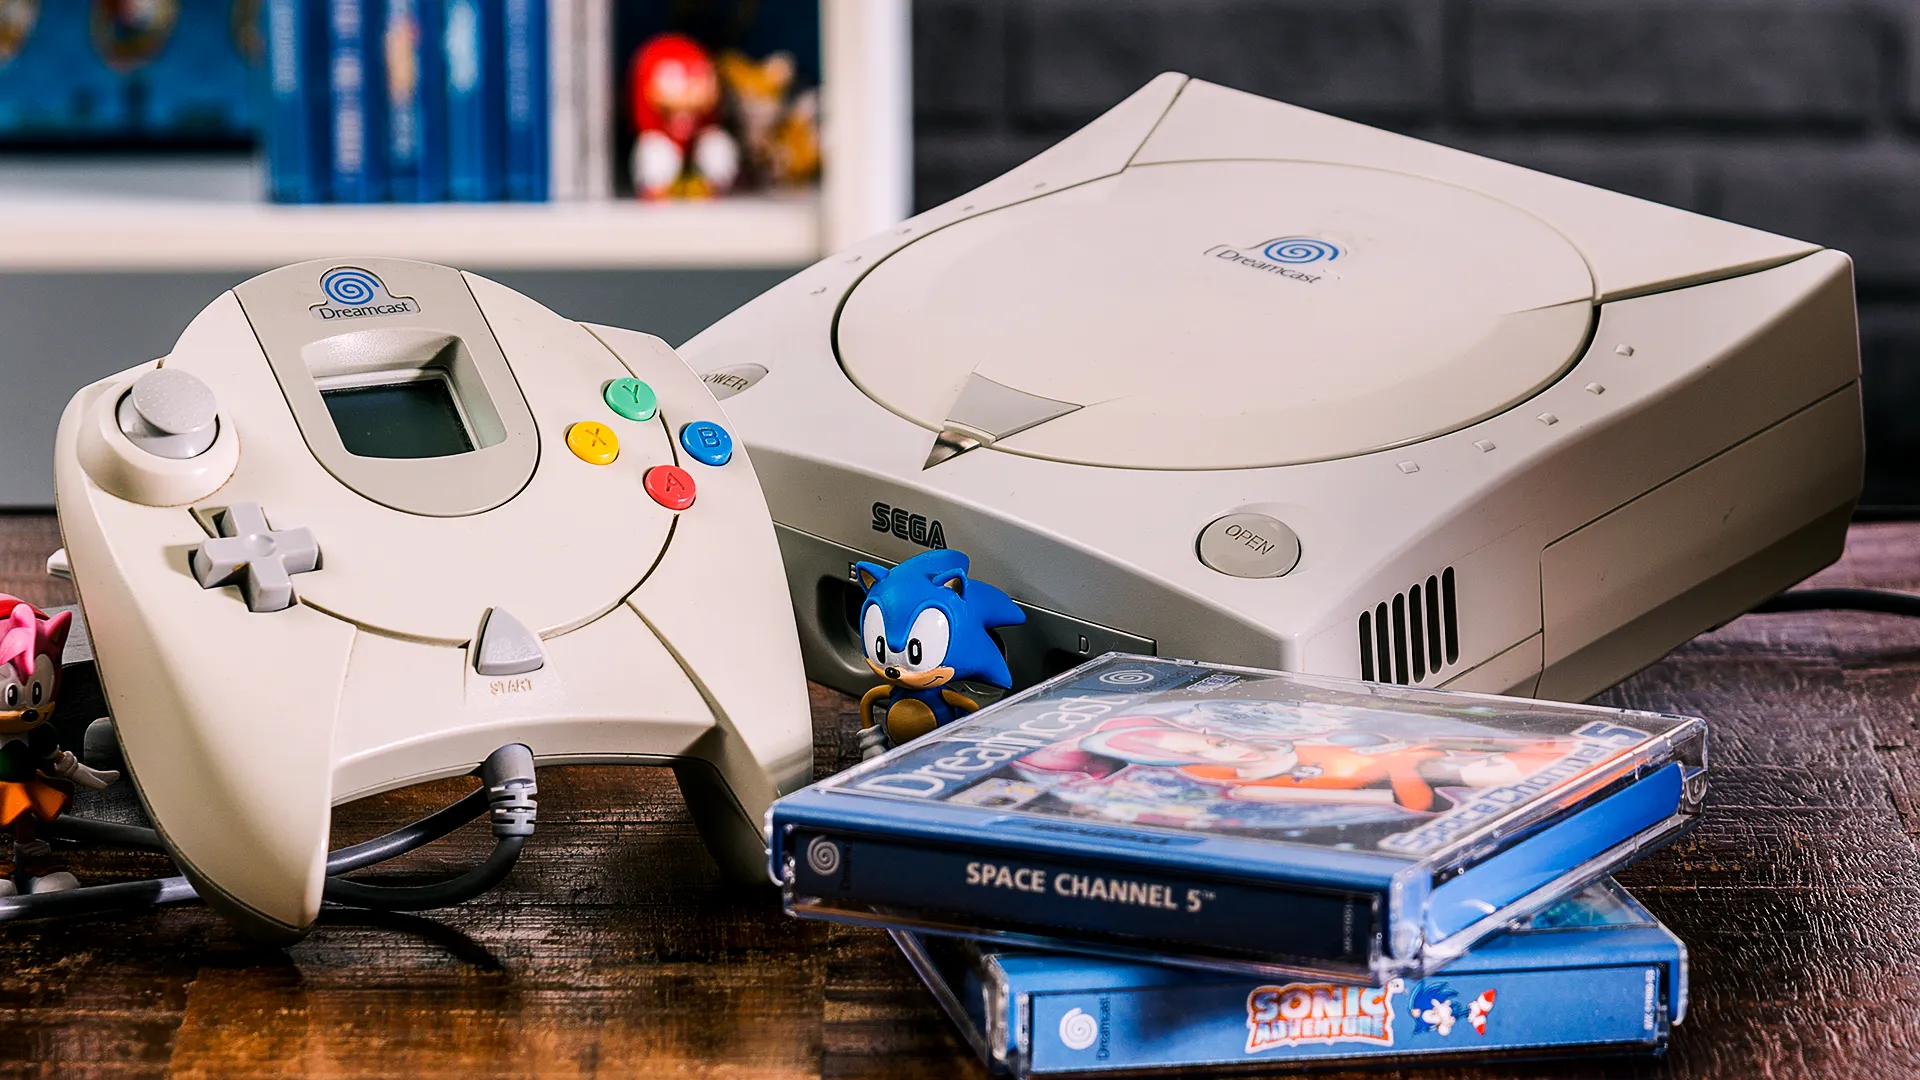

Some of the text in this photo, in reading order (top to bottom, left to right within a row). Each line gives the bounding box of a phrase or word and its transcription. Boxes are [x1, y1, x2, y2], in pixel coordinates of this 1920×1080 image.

[1216, 249, 1322, 284] Dreamcast
[319, 301, 411, 320] Dreamcast
[622, 384, 640, 404] Y
[700, 373, 748, 391] OWER
[584, 428, 607, 447] X
[698, 426, 721, 449] B
[665, 471, 686, 492] A
[872, 501, 948, 549] SEGA
[1225, 524, 1275, 555] OPEN
[1078, 634, 1091, 654] D
[489, 678, 532, 696] START
[857, 694, 1128, 798] Dreamcast
[1386, 722, 1648, 849] Space Channel 5
[966, 861, 1046, 892] SPACE
[1054, 873, 1178, 909] CHANNEL
[1253, 985, 1387, 1022] SONIC
[1253, 1015, 1388, 1045] ADVENTURE
